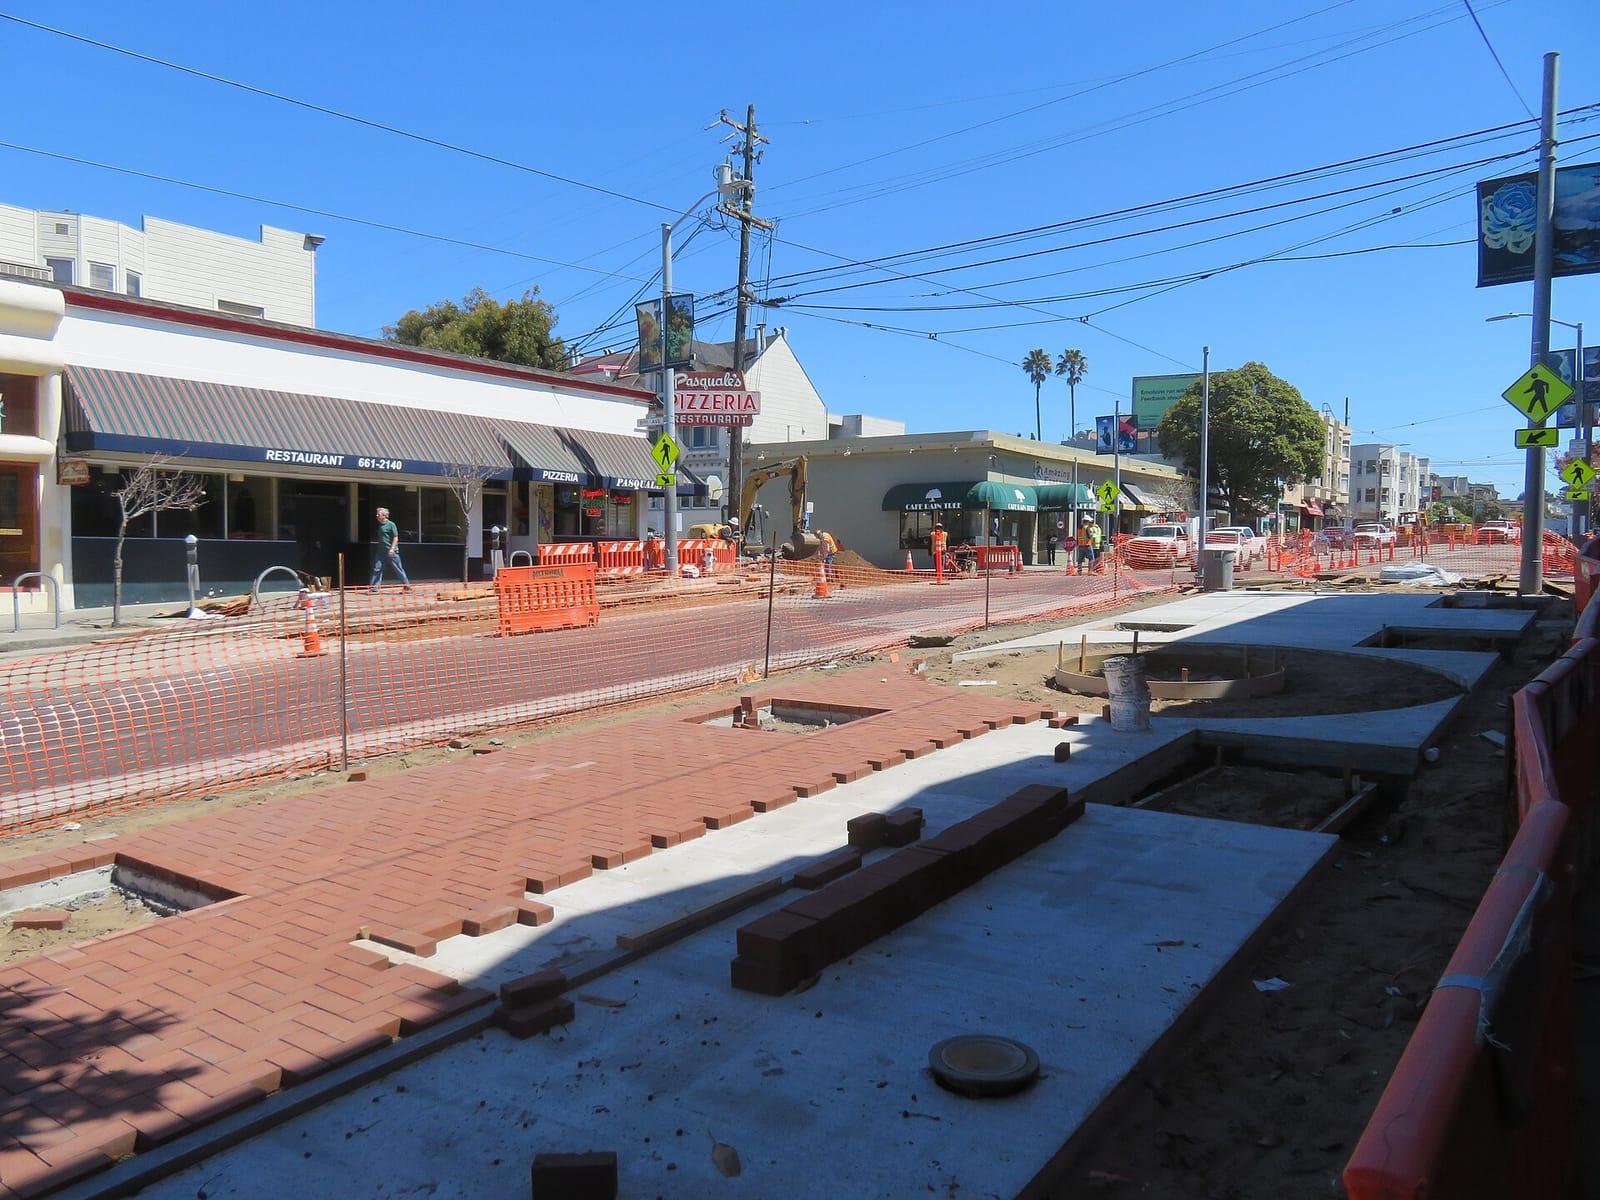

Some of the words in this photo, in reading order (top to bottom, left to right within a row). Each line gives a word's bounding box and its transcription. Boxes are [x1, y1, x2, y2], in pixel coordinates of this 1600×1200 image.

[674, 372, 742, 391] Pasquale's
[266, 450, 344, 466] RESTAURANT
[358, 457, 402, 470] 661-2140
[542, 470, 578, 483] PIZZERIA
[1043, 466, 1071, 480] Amazing
[1063, 540, 1075, 548] STOP
